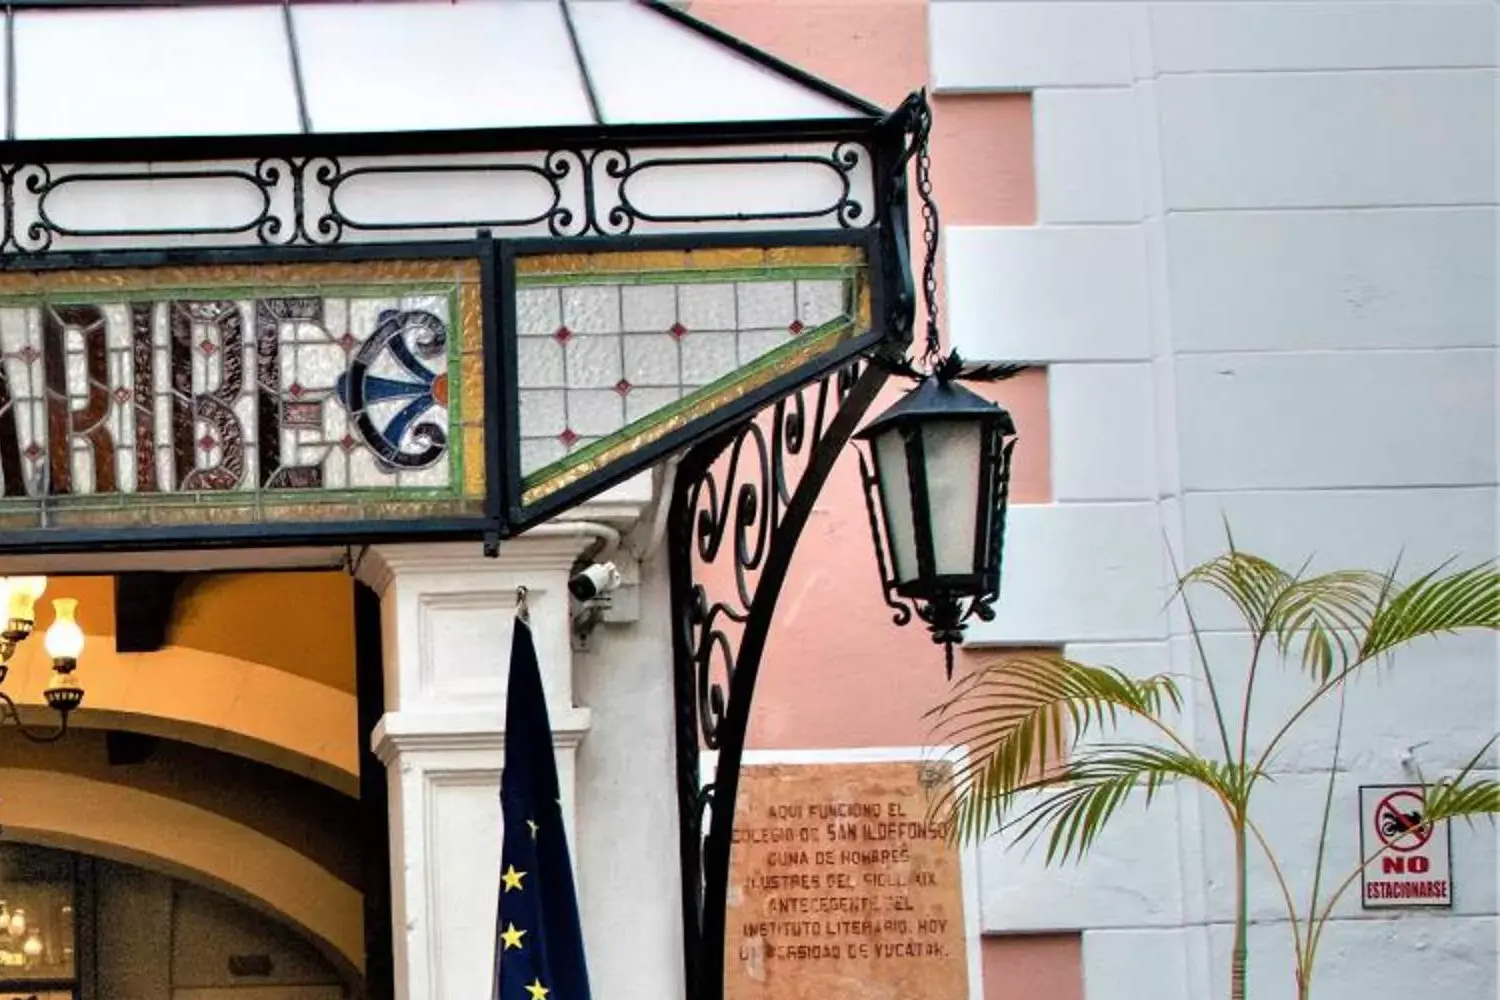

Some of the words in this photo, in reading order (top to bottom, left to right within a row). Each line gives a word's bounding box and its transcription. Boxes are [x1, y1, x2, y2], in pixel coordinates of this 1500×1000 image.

[768, 804, 803, 820] AQUI
[888, 803, 907, 817] EL
[827, 822, 854, 842] SAN
[863, 821, 948, 841] ILDEFONSO
[767, 851, 809, 867] CUNA
[815, 850, 835, 865] DE
[841, 849, 910, 866] HOMBRES
[1382, 856, 1430, 874] NO
[826, 873, 856, 889] DEL
[1367, 880, 1447, 899] ESTACIONARSE
[743, 922, 821, 937] INSTITUTO
[918, 919, 948, 934] HOY
[848, 945, 869, 959] DE
